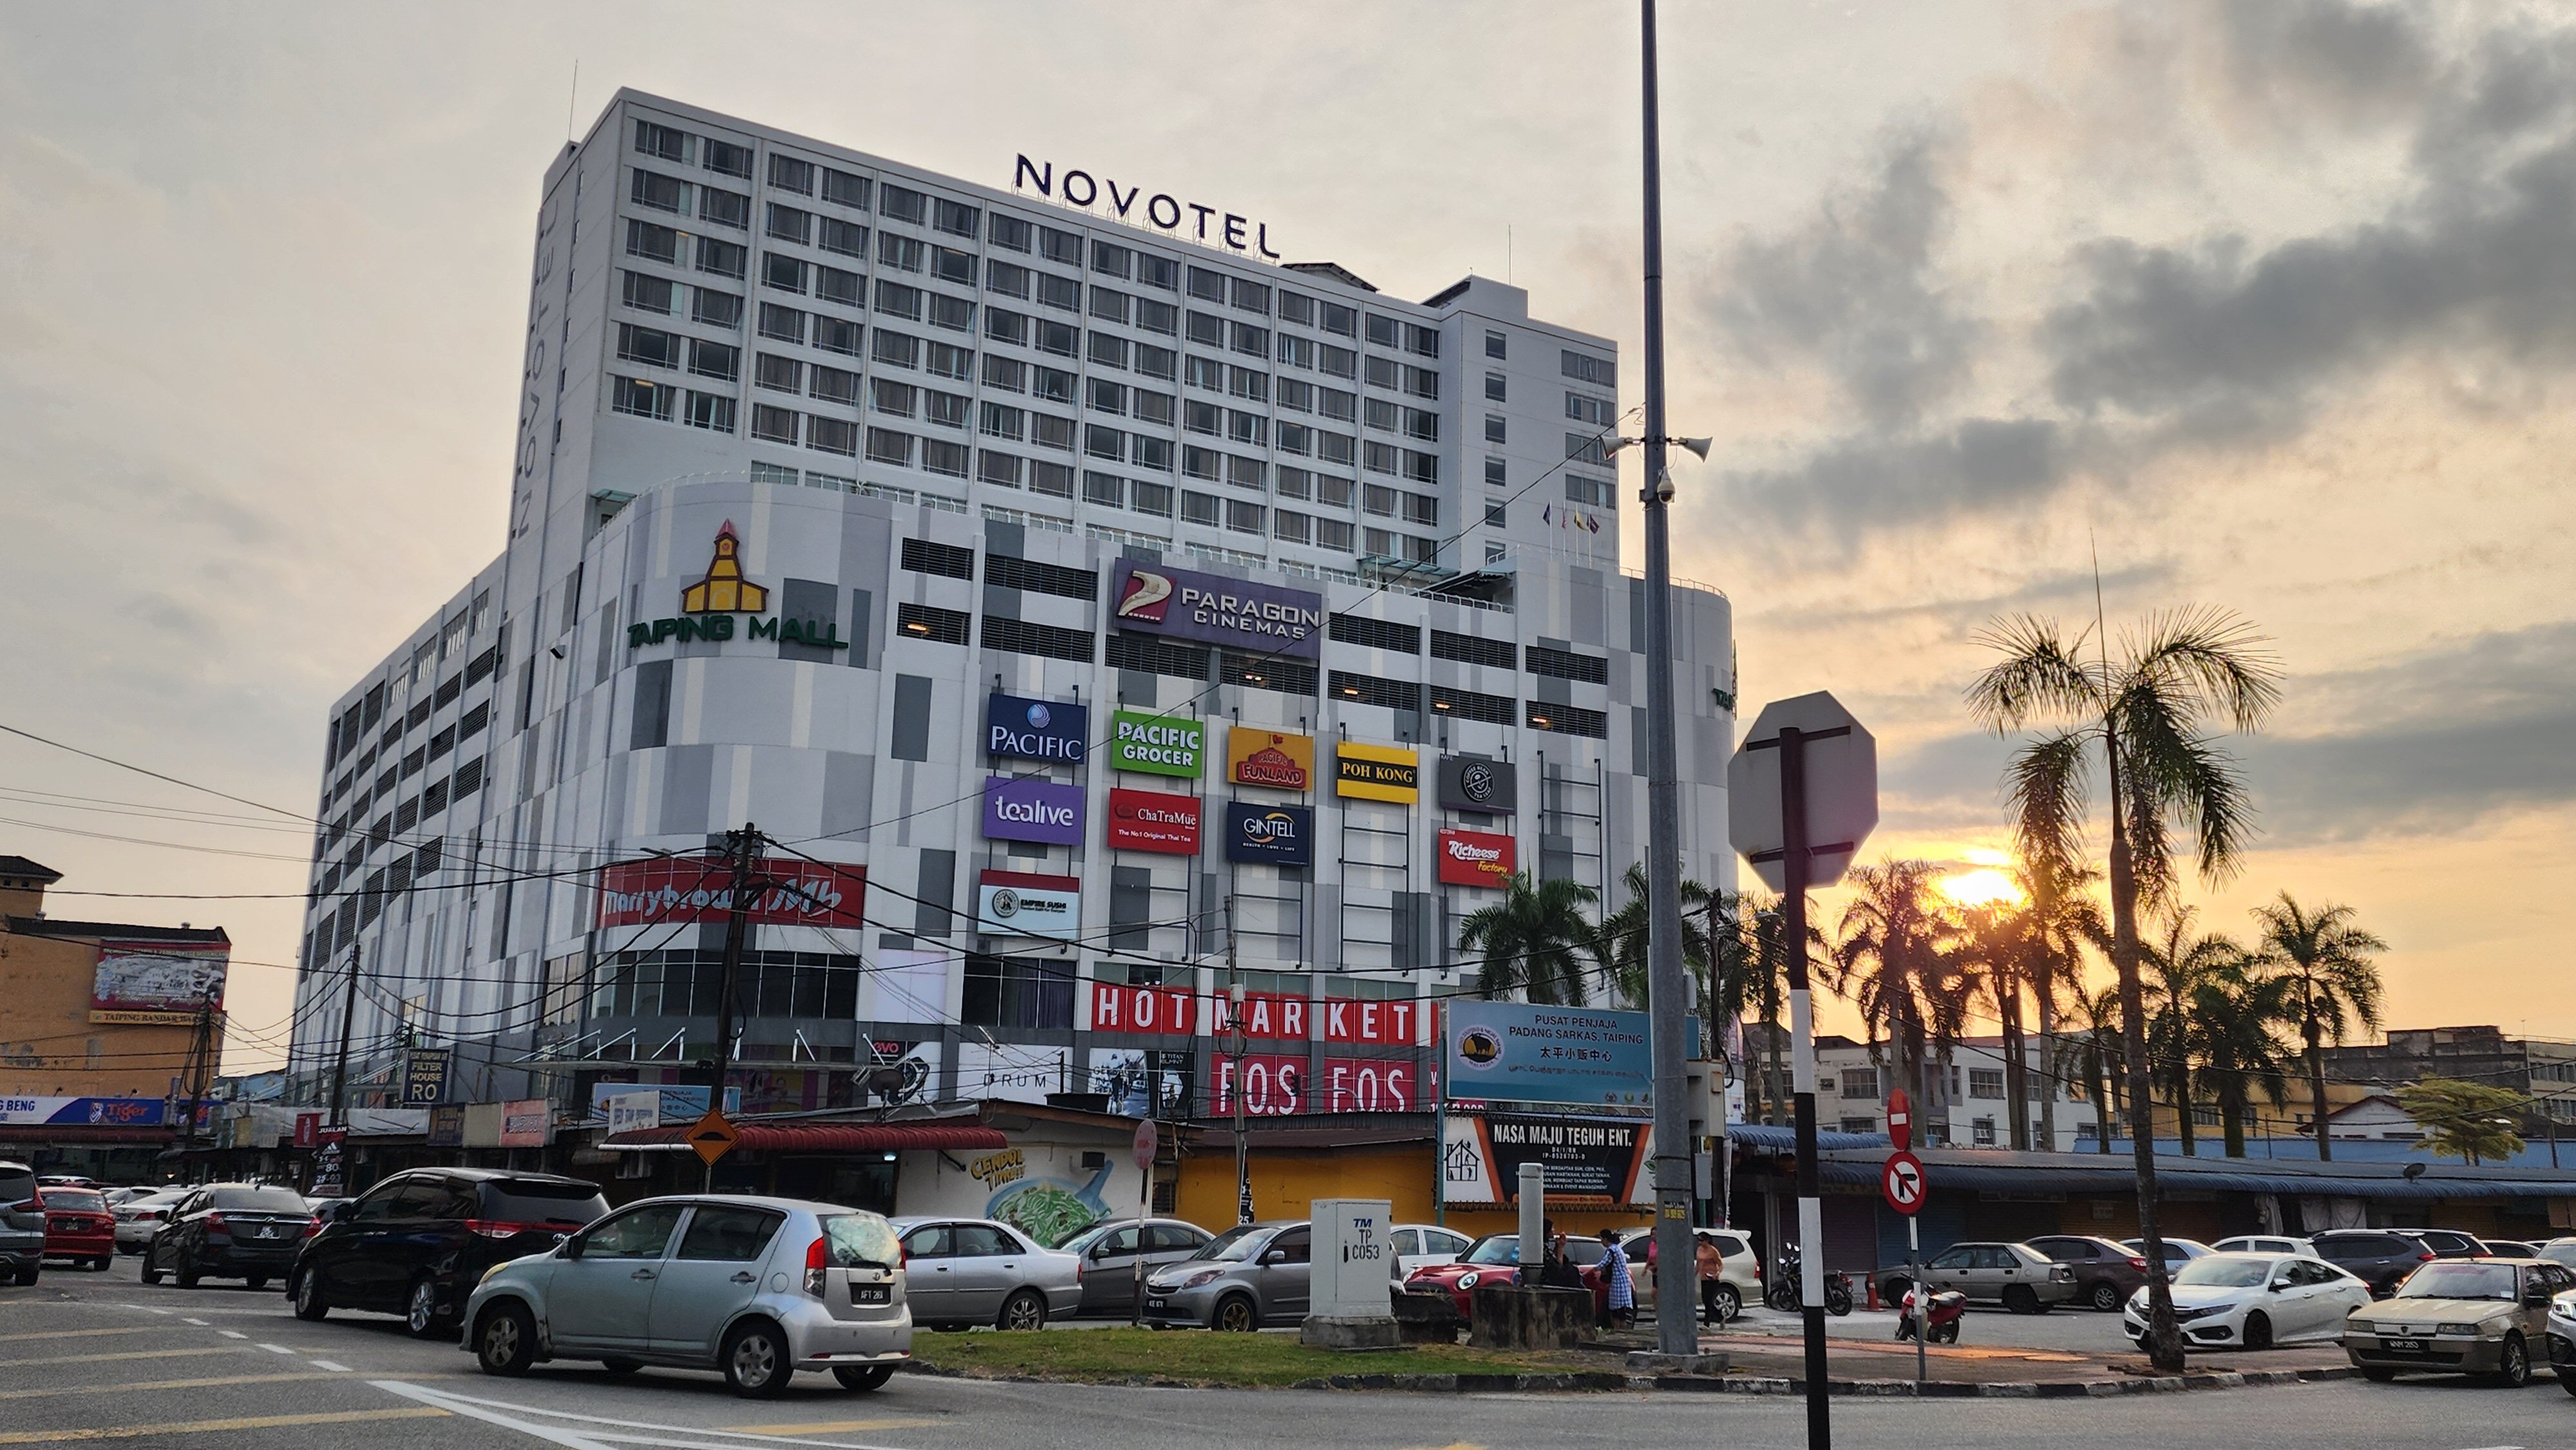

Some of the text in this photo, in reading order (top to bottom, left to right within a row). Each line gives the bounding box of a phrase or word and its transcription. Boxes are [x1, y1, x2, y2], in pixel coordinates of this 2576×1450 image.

[1016, 153, 1281, 259] NOVOTEL
[517, 200, 558, 539] NOVOTEL
[1181, 587, 1319, 628] PARAGON
[627, 615, 849, 649] TAIPING MALL
[1193, 610, 1305, 640] CINEMAS
[990, 725, 1083, 760] PACIFIC
[1117, 721, 1200, 750] PACIFIC
[1122, 746, 1193, 767] GROCER
[1258, 751, 1288, 766] PACIFIC
[1242, 763, 1302, 784] FUNLAND
[1341, 762, 1413, 783] POH KONG
[995, 795, 1074, 827] tealive
[1137, 808, 1197, 825] ChaTraMue
[1143, 831, 1166, 840] Original
[1244, 818, 1296, 838] GINTELL
[1448, 840, 1500, 861] Richeese
[1477, 861, 1508, 874] Factory
[1020, 899, 1046, 907] EMPIRE
[1098, 988, 1409, 1040] HOT MARKET
[1535, 1014, 1618, 1030] PUSAT PENJAJA
[1509, 1026, 1553, 1039] PADANG
[1603, 1032, 1643, 1044] TAIPING
[412, 1062, 442, 1071] FILTER
[410, 1072, 443, 1082] HOUSE
[983, 1073, 1047, 1088] DRUM
[412, 1083, 437, 1100] RO
[1220, 1062, 1296, 1115] FO.S
[6, 1100, 35, 1112] BENG
[107, 1102, 149, 1122] Tiger
[1494, 1124, 1632, 1147] NASA MAJU TEGUH ENT.
[325, 1163, 339, 1172] 80
[971, 1149, 1025, 1180] CENDOL
[1353, 1218, 1372, 1228] TM
[1359, 1229, 1372, 1244] TP
[1352, 1244, 1379, 1259] C053
